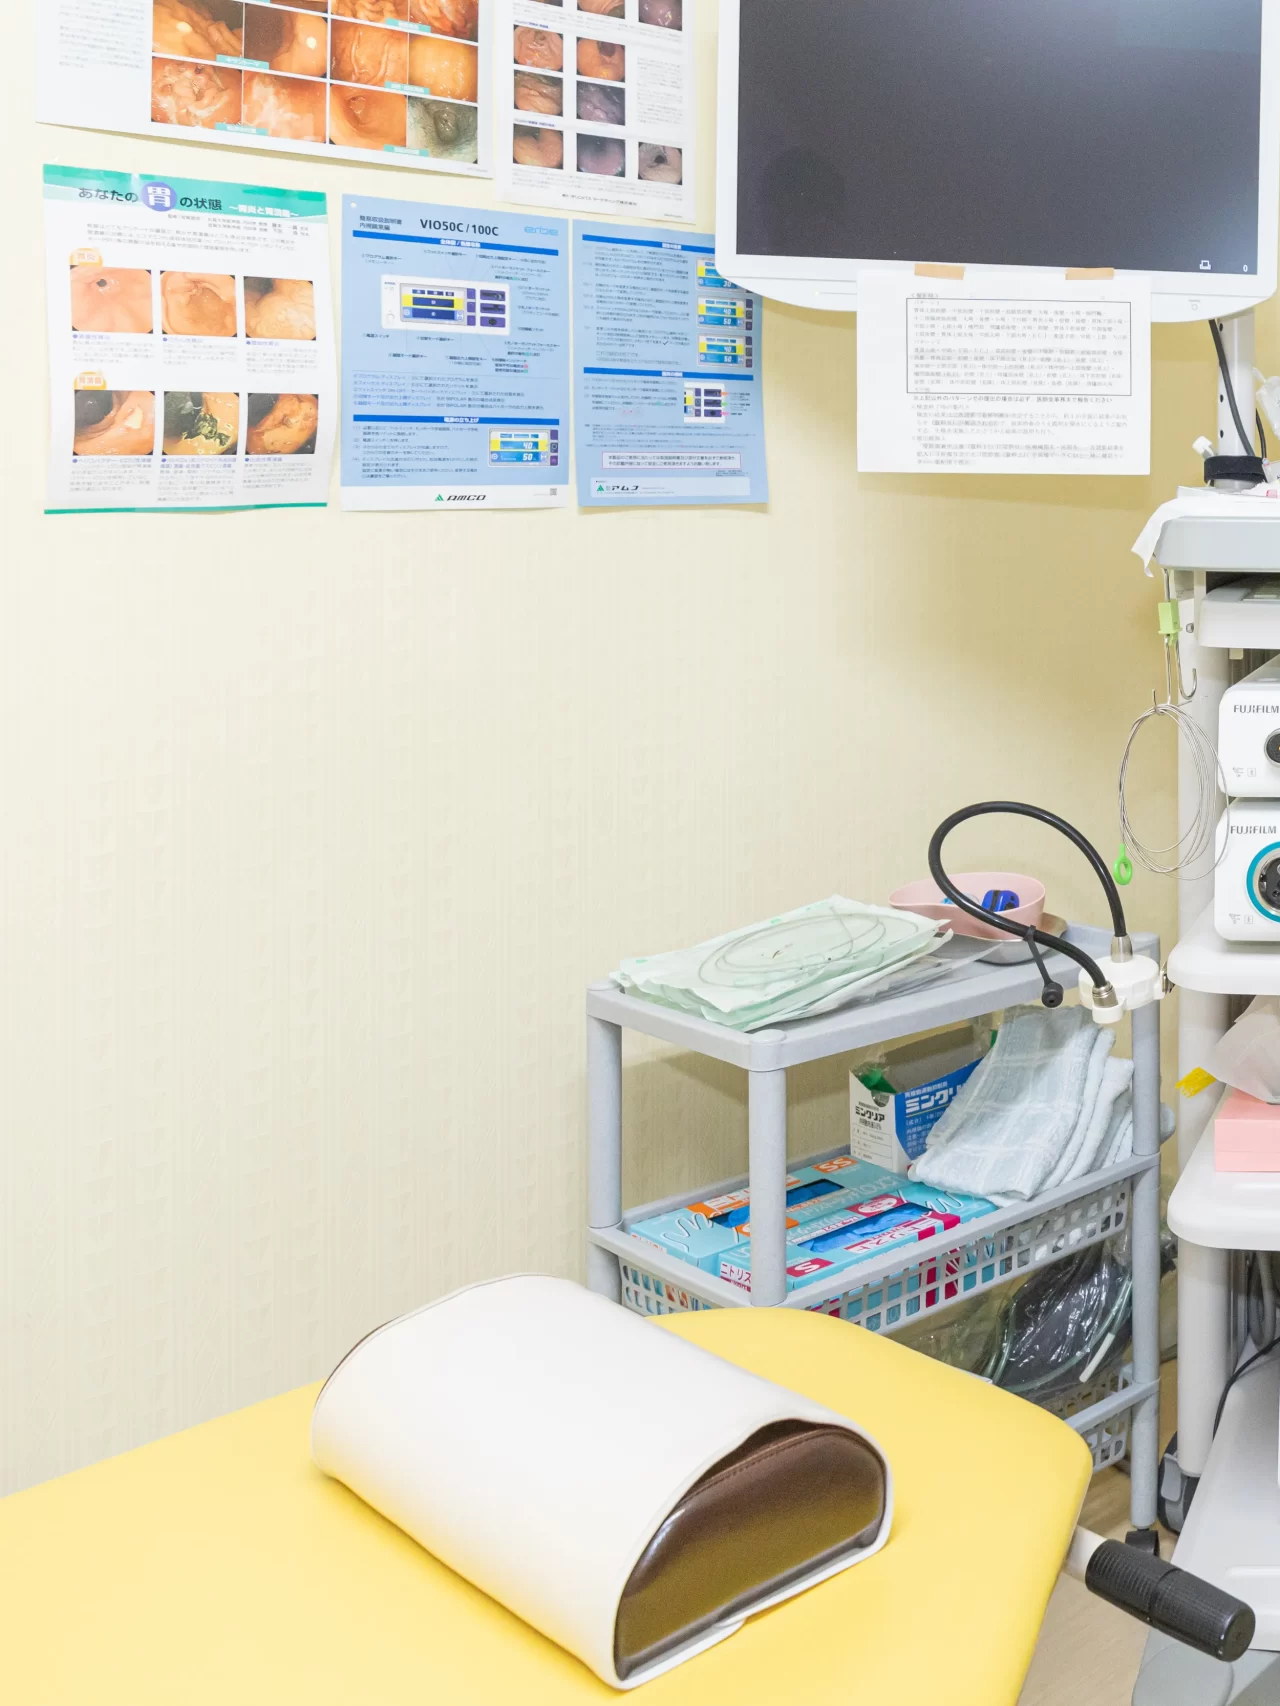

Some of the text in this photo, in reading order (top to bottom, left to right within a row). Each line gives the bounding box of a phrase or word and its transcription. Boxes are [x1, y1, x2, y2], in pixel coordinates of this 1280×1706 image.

[78, 183, 223, 211] あなたの胃の状態
[419, 218, 464, 233] VIO50C
[471, 224, 499, 236] 100C
[524, 226, 559, 236] erbe
[447, 494, 486, 502] AMCO
[1233, 704, 1280, 714] FUJIFILM
[1230, 825, 1277, 834] FUJIFILM
[855, 1105, 885, 1122] ミンクリア
[817, 1157, 855, 1173] SS
[720, 1263, 752, 1285] ニトリス
[793, 1261, 821, 1274] S
